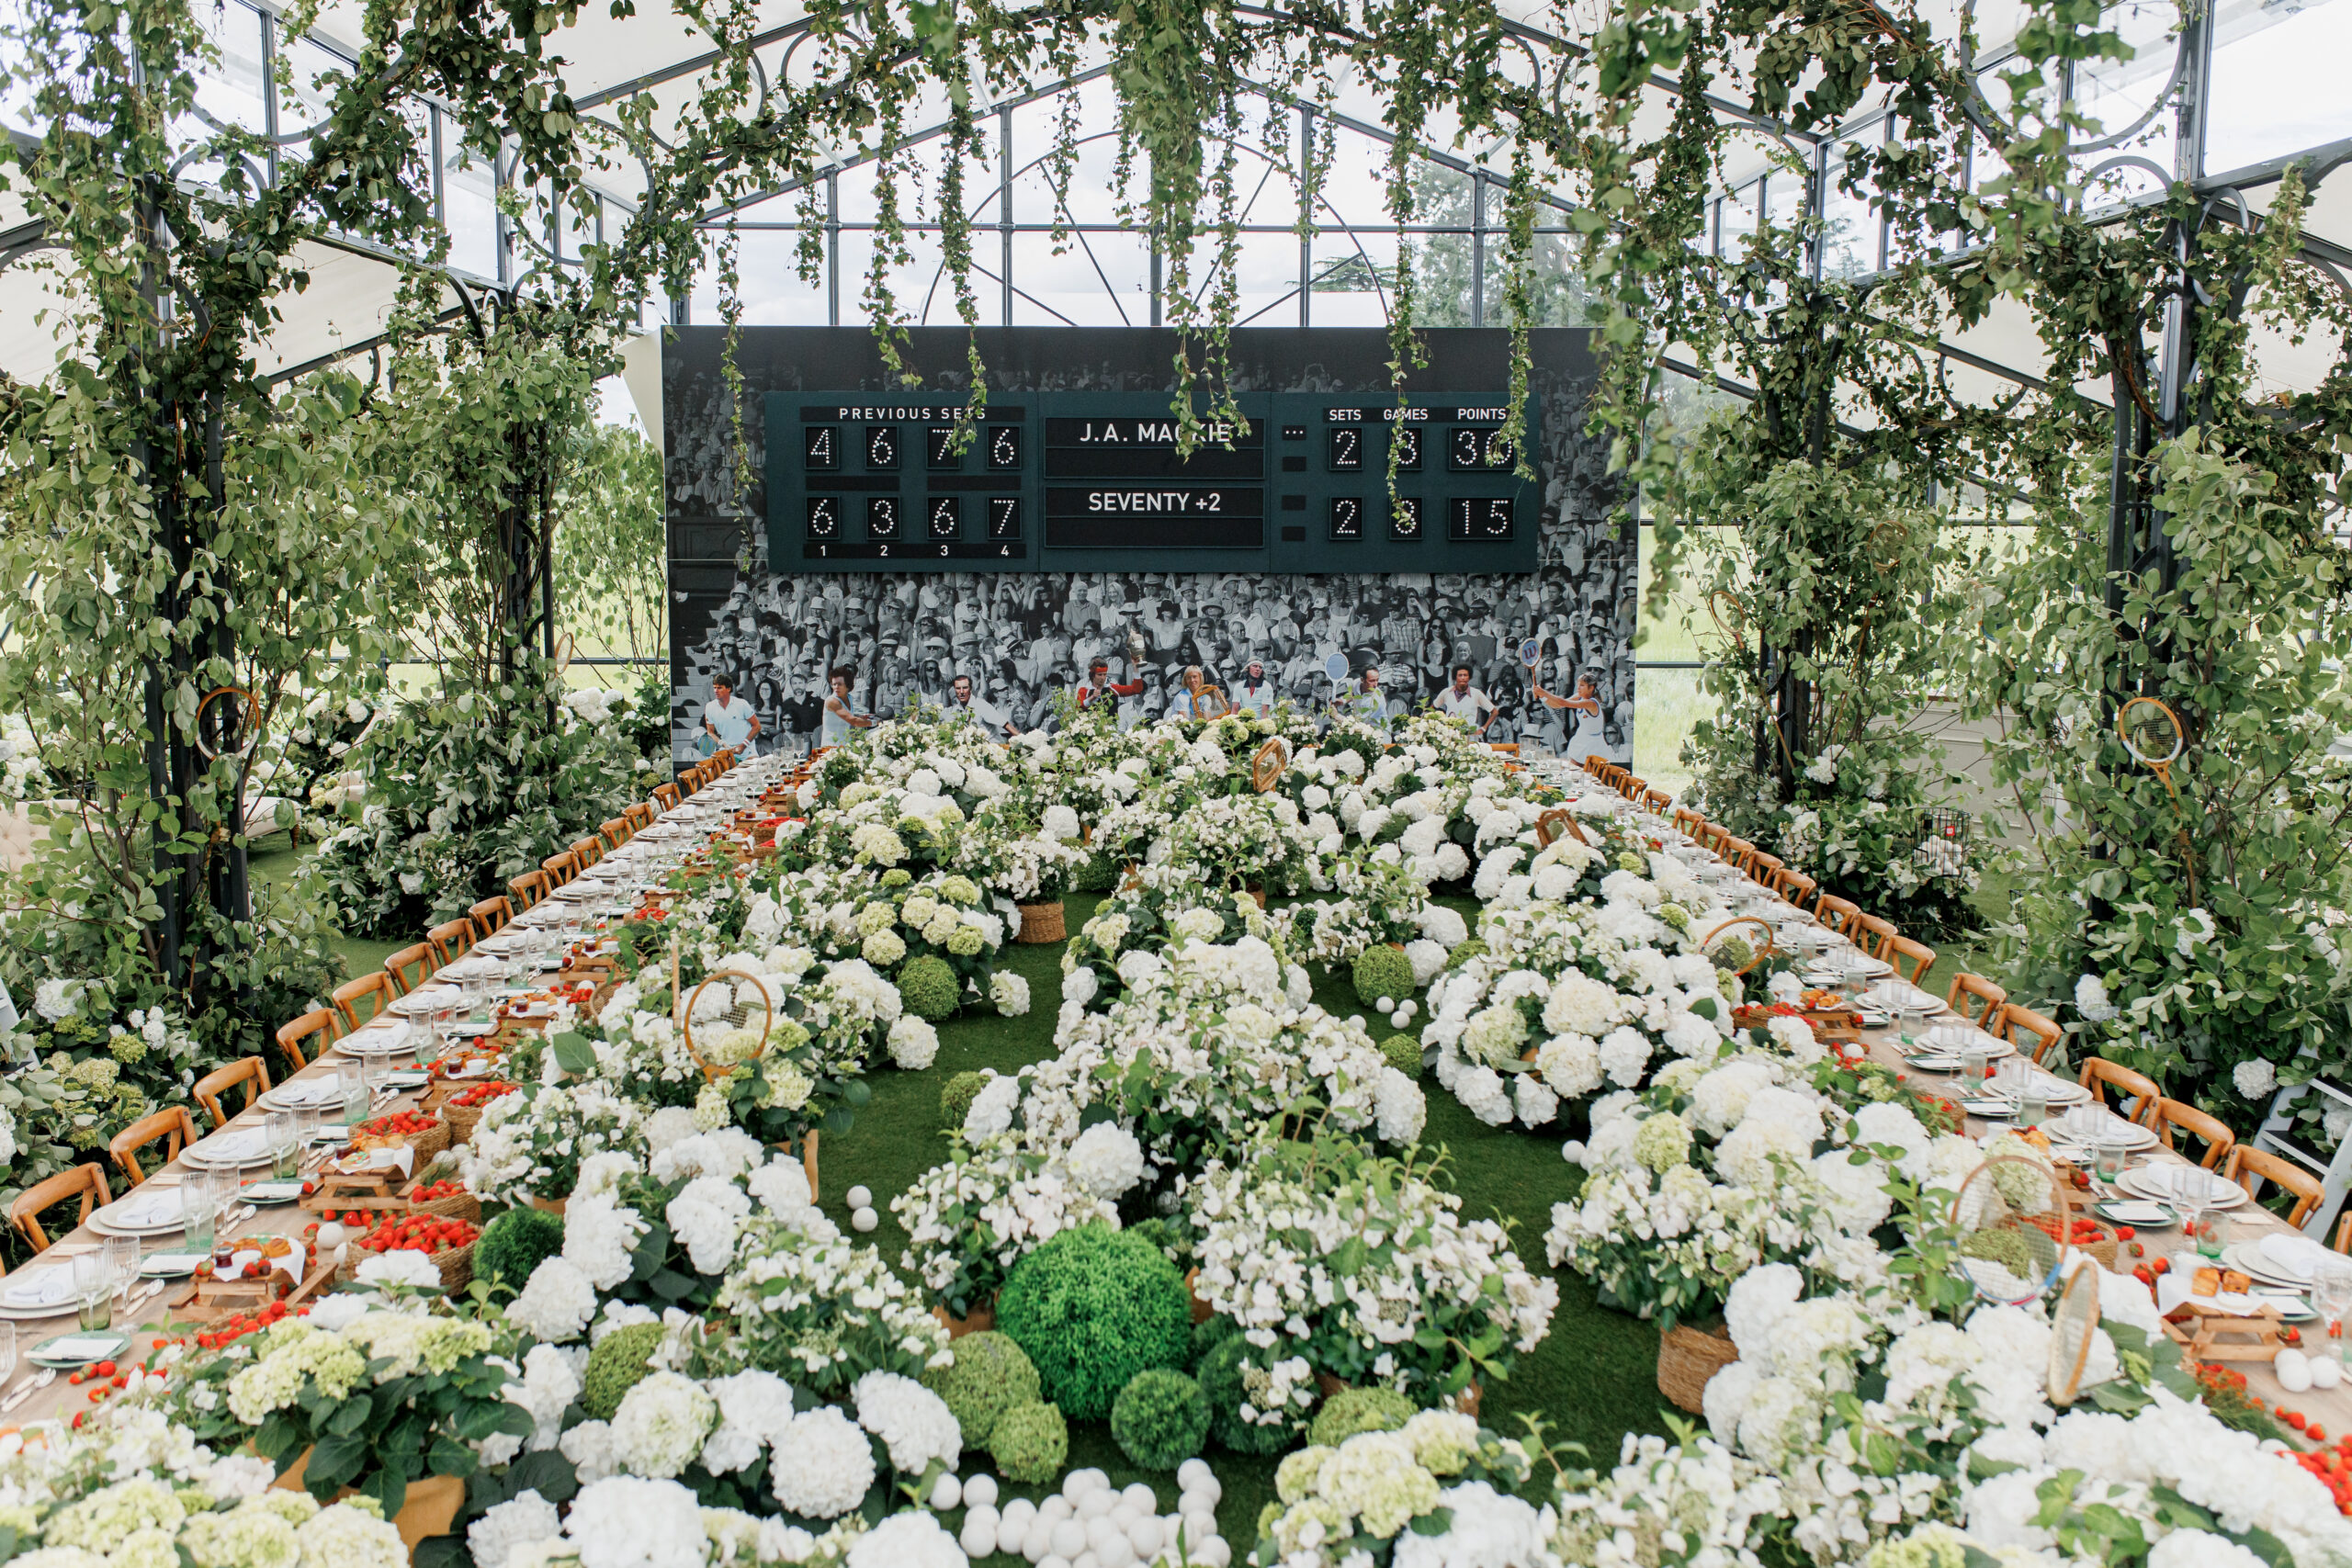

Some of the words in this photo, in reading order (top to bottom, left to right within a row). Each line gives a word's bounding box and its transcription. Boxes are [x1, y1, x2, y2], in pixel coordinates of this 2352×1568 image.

[839, 407, 931, 420] PREVIOUS
[1329, 409, 1362, 421] SETS
[1383, 409, 1429, 421] GAMES
[1457, 409, 1507, 420] POINTS
[1080, 423, 1128, 442] J.A.
[810, 429, 830, 464] 4
[872, 428, 893, 465] 6
[932, 428, 954, 460] 7
[993, 428, 1015, 465] 6
[1336, 430, 1357, 465] 2
[1455, 430, 1512, 466] 30
[1089, 492, 1190, 512] SEVENTY
[1195, 492, 1221, 512] +2
[812, 499, 833, 535] 6
[873, 500, 894, 535] 3
[933, 499, 955, 535] 6
[993, 500, 1015, 535] 7
[1336, 500, 1357, 535] 2
[1462, 500, 1509, 535] 15
[820, 545, 826, 557] 1
[880, 545, 888, 557] 2
[940, 545, 949, 557] 3
[1001, 545, 1010, 557] 4
